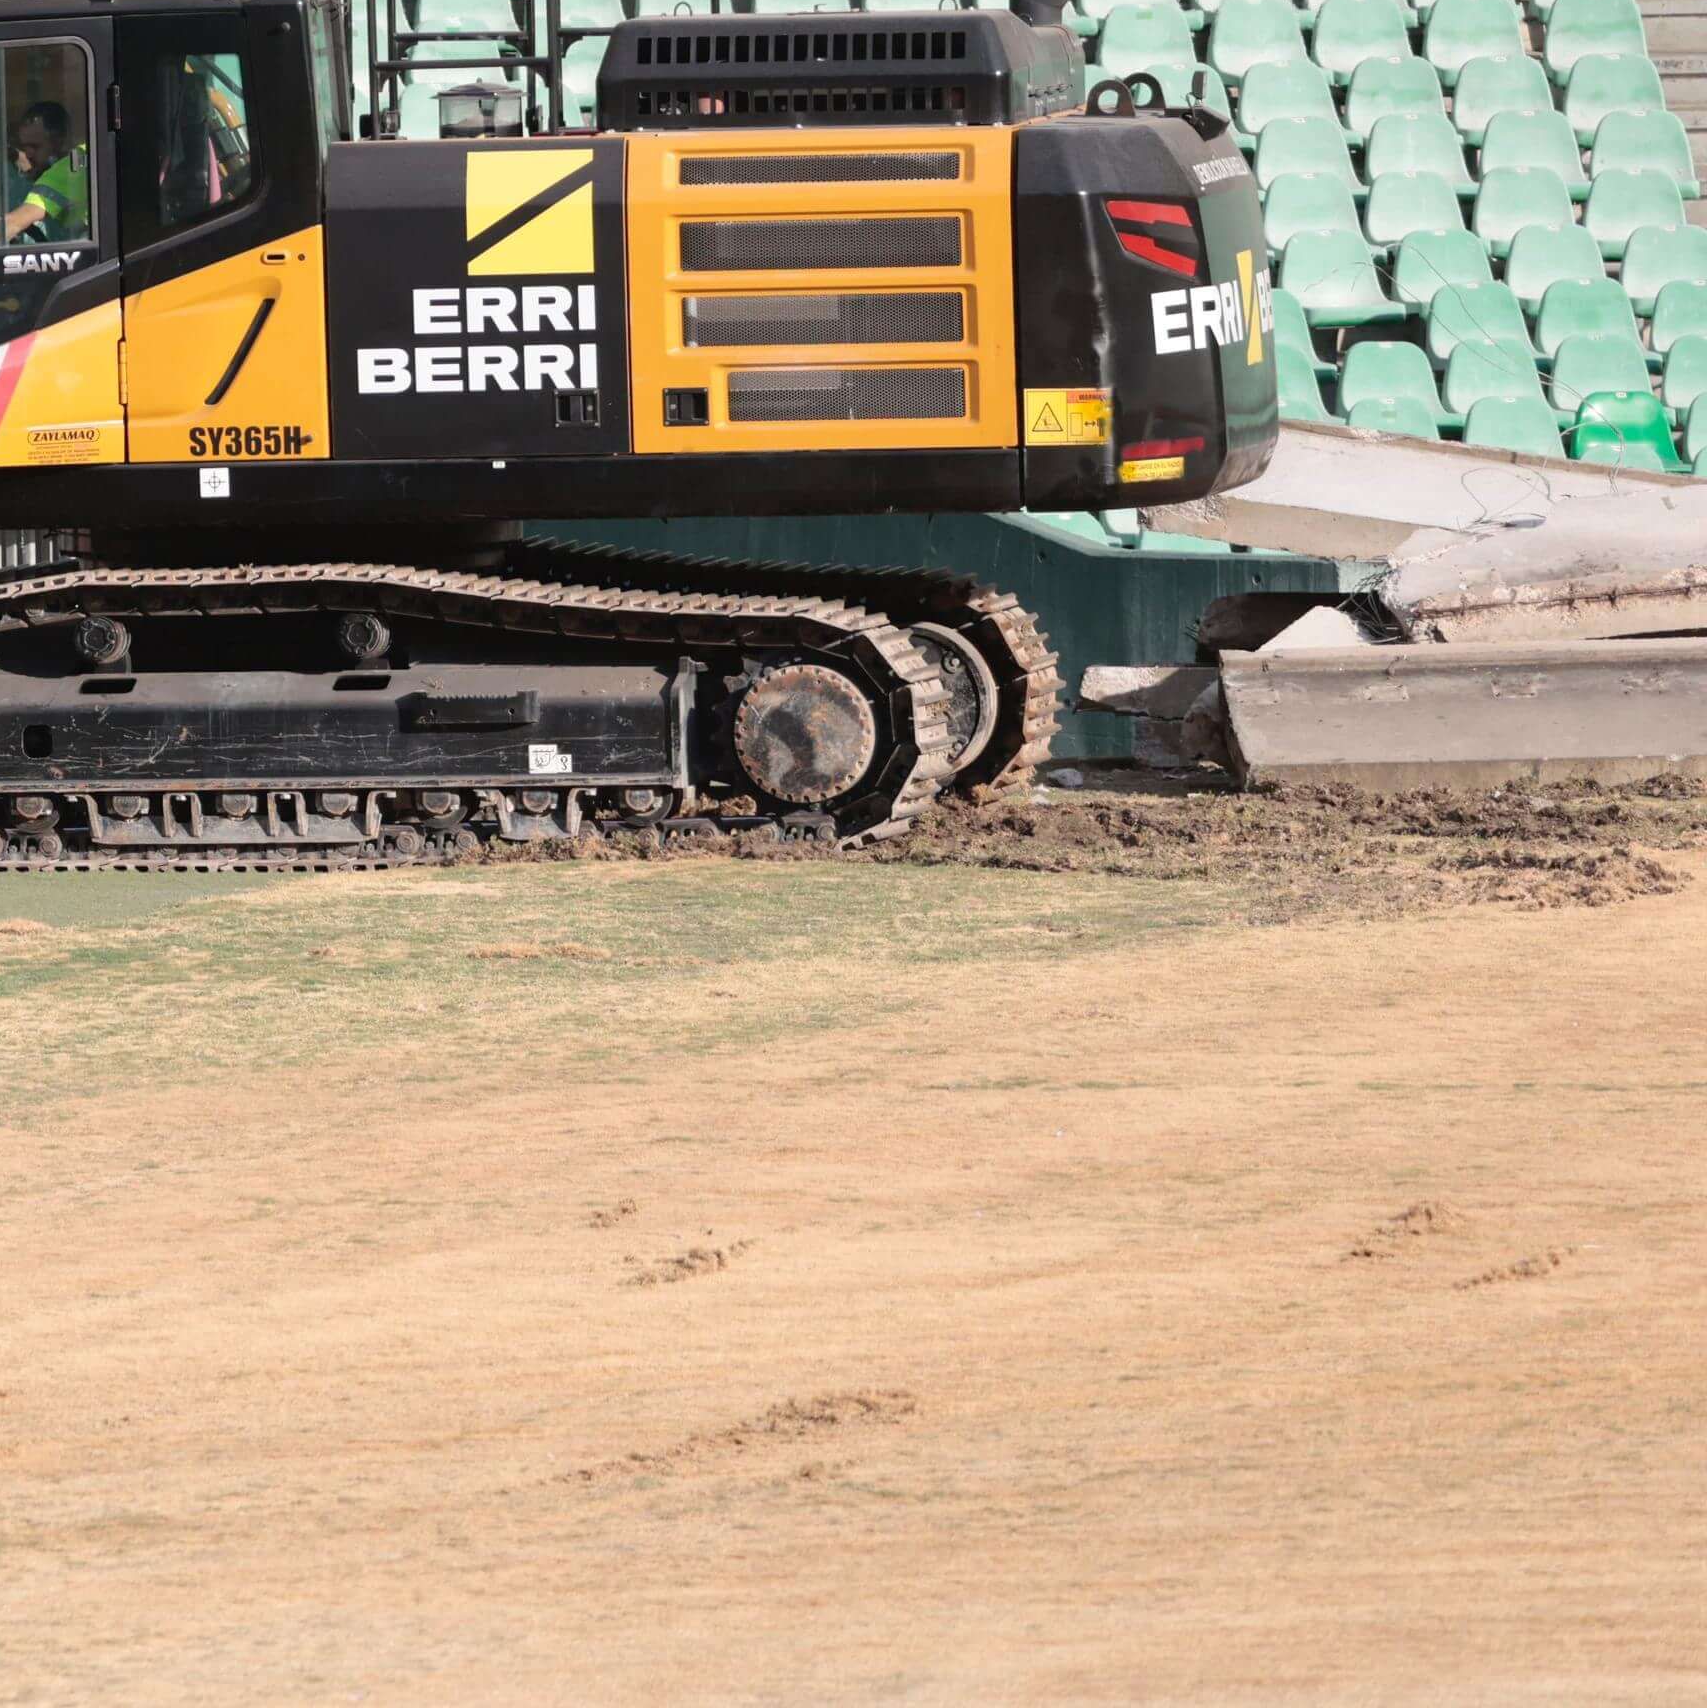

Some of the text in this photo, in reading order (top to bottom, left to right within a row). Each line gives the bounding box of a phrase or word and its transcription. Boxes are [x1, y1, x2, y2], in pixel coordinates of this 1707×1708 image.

[2, 251, 81, 274] SANY
[412, 284, 597, 335] ERRI
[1150, 279, 1244, 355] ERRI
[357, 343, 598, 394] BERRI
[33, 429, 95, 443] ZAYLAMAQ
[189, 425, 302, 457] SY365H
